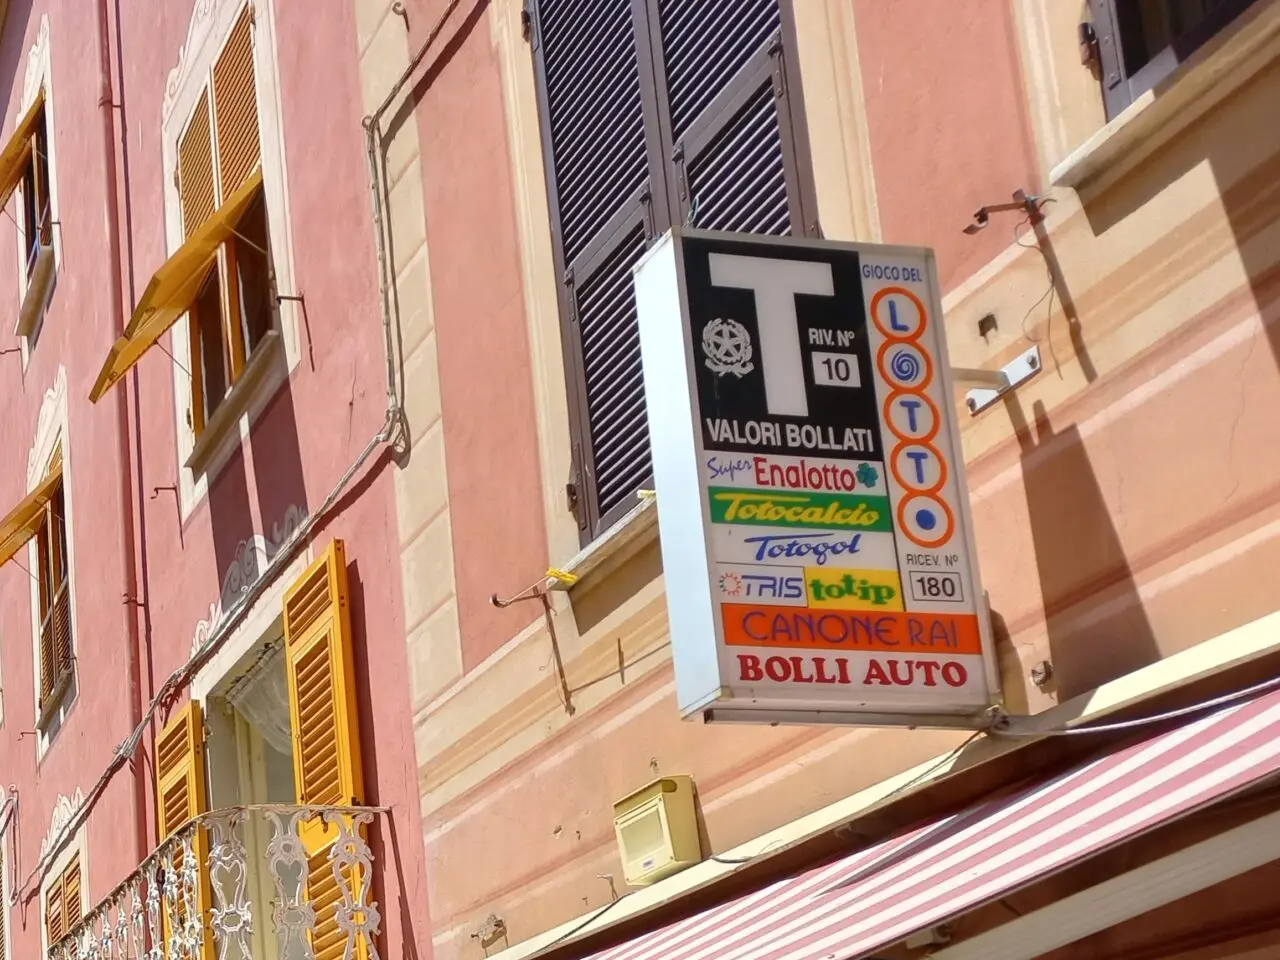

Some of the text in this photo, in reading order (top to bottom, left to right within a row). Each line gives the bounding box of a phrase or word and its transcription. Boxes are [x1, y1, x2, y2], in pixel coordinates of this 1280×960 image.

[862, 265, 923, 283] GIOCO DEL
[708, 253, 835, 417] T
[808, 328, 835, 345] RIV.
[821, 358, 851, 383] 10
[706, 418, 873, 452] VALORI BOLLATI
[706, 456, 855, 492] Super Enalotto
[713, 492, 879, 527] Totocalcio
[744, 533, 861, 565] Totogol
[906, 553, 939, 567] RICEV.
[740, 573, 897, 606] TRIS totip
[916, 575, 956, 597] 180
[742, 611, 958, 648] CANONE RAI
[736, 654, 969, 688] BOLLI AUTO
